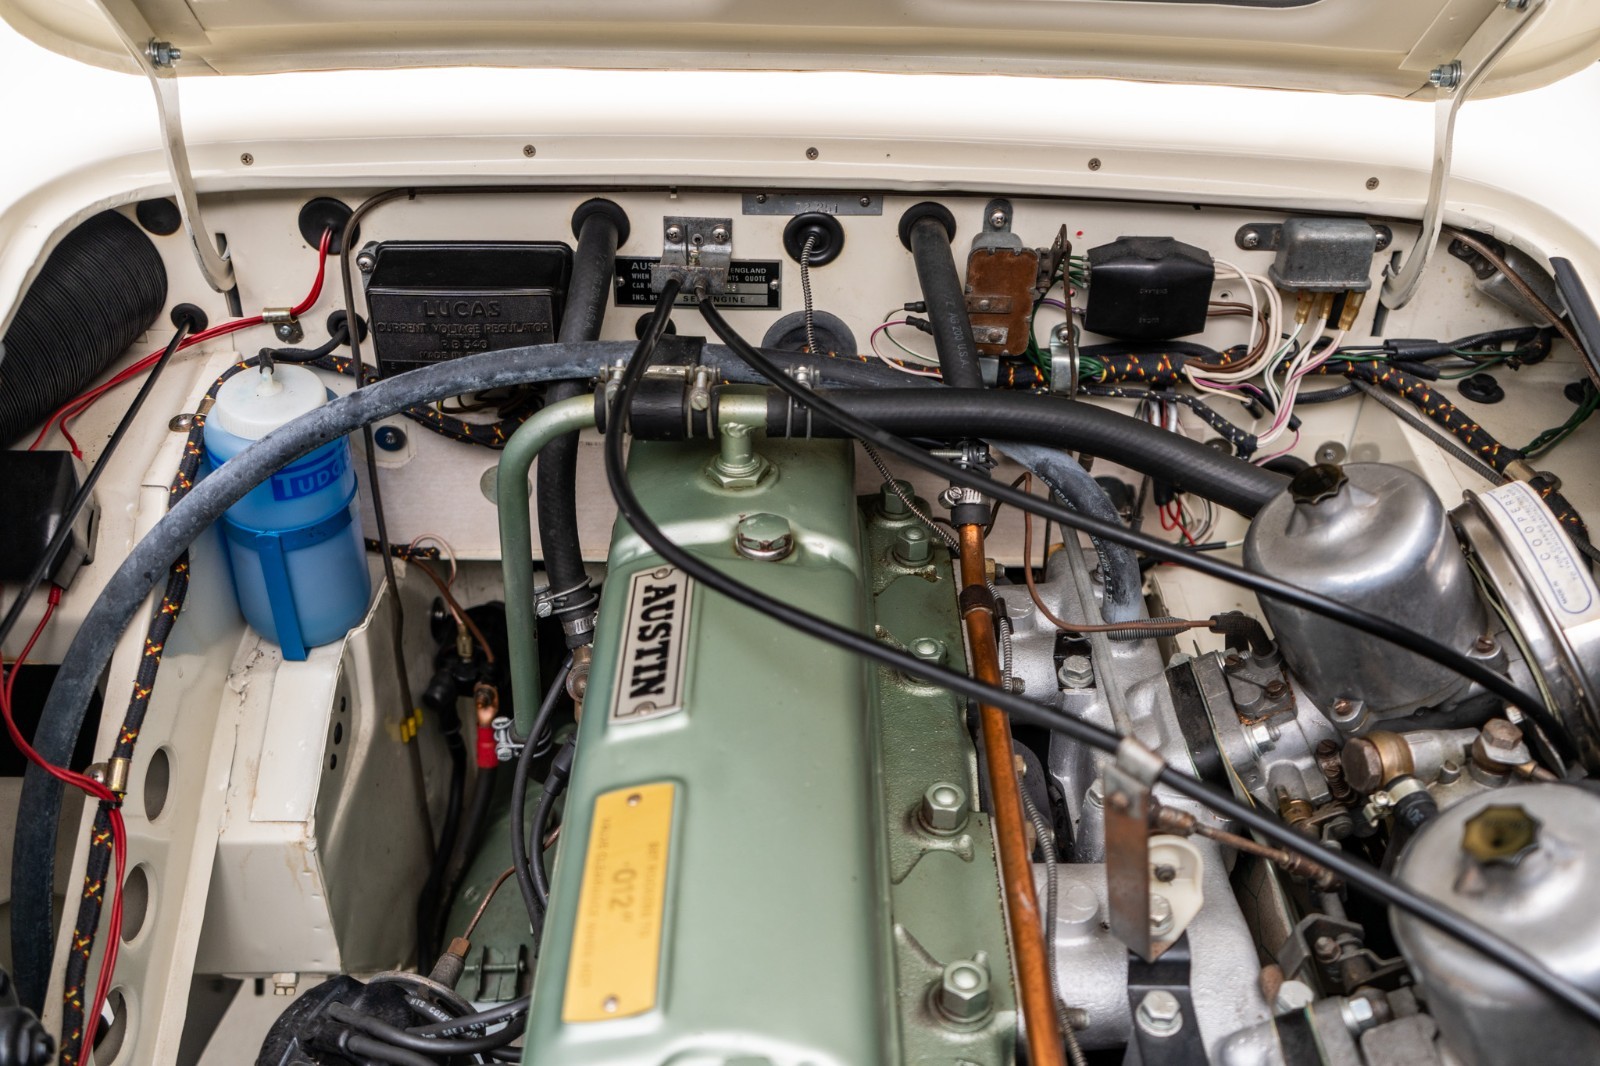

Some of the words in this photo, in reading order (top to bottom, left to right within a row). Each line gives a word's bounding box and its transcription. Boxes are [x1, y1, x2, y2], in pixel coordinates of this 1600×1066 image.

[376, 322, 427, 334] CURRENT
[433, 323, 481, 335] VOLTAGE
[483, 322, 549, 335] REGULATOR
[423, 300, 501, 318] LUCAS
[1499, 494, 1552, 562] COOPERS
[629, 584, 677, 699] AUSTIN
